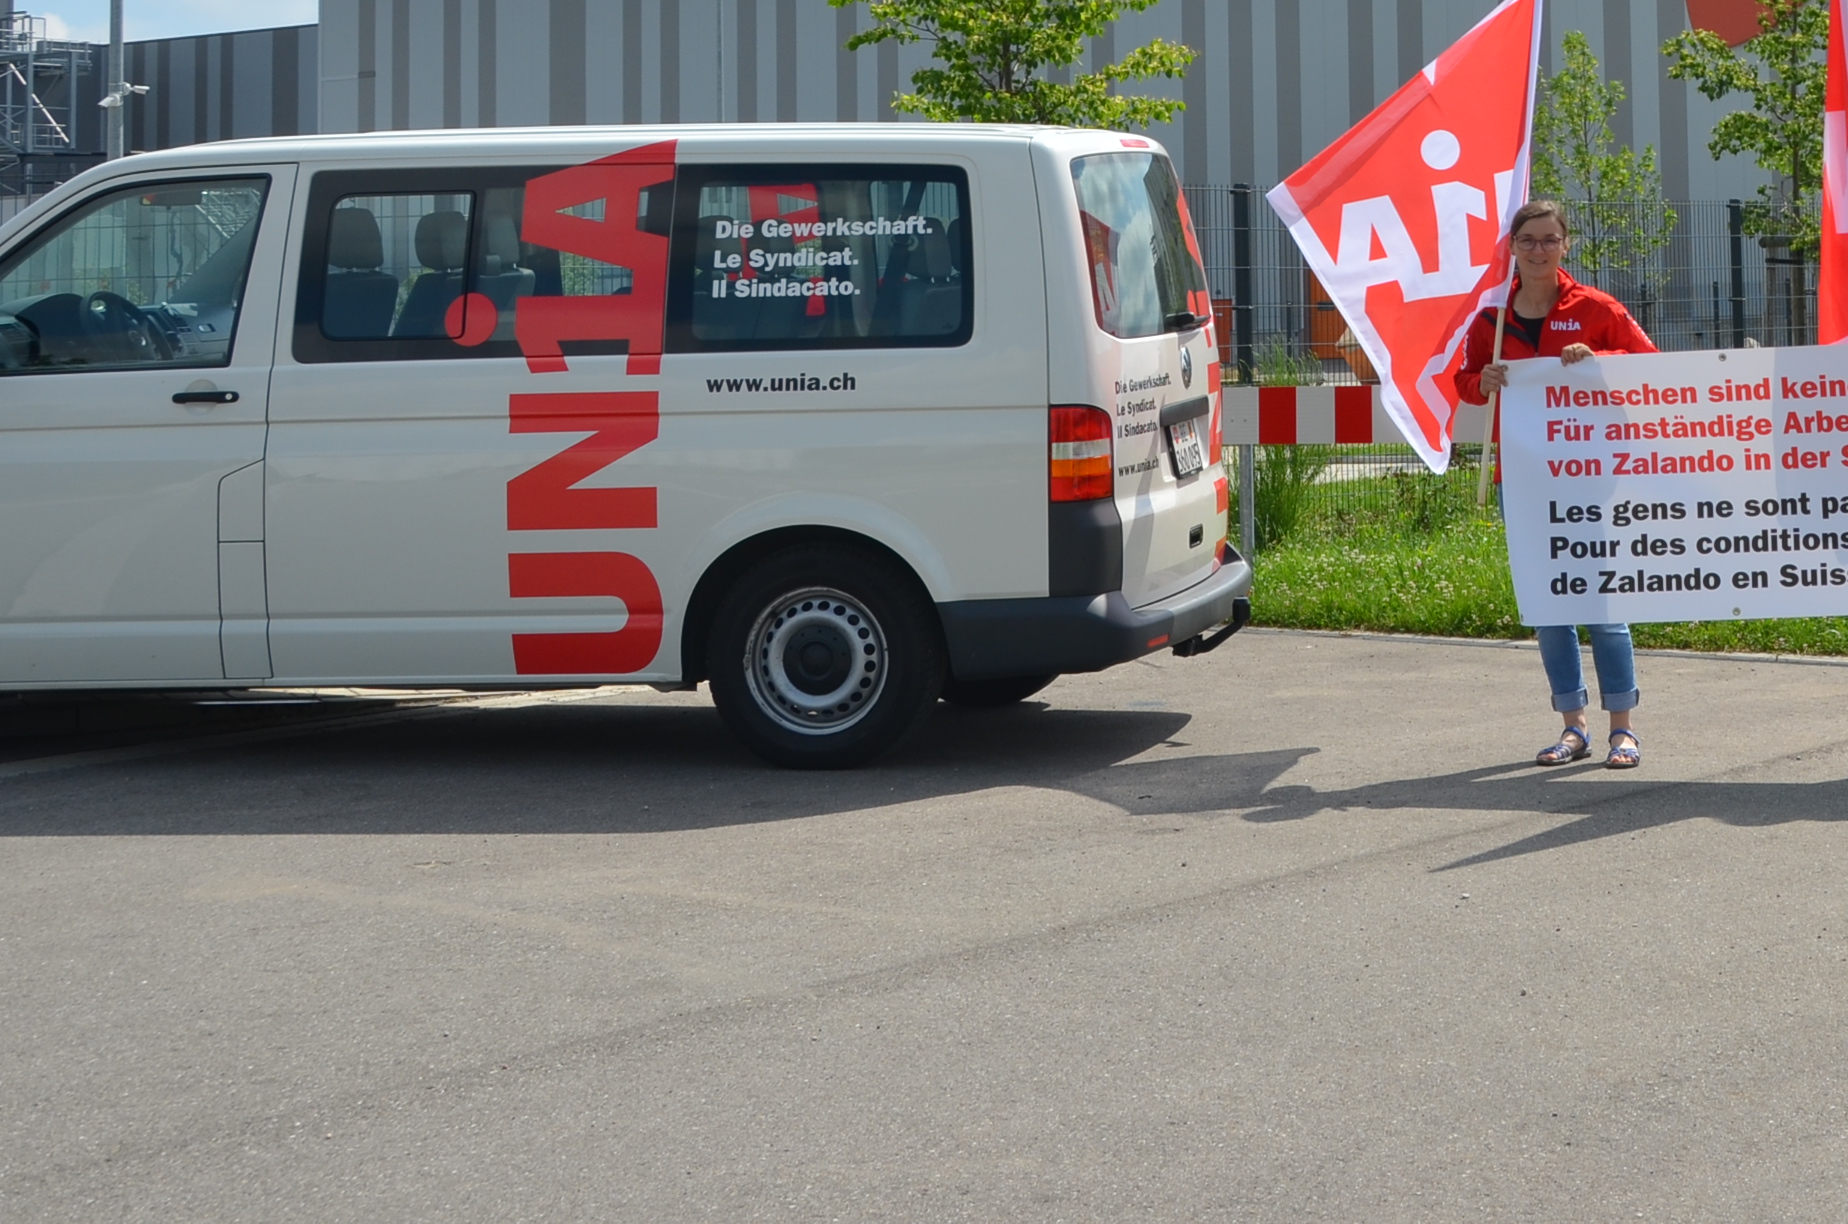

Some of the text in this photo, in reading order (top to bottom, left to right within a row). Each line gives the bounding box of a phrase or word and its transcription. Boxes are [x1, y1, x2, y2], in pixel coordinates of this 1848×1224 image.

[715, 216, 933, 239] Die Gewerkschaft.
[713, 247, 859, 271] Le Syndicat.
[712, 278, 861, 298] Il Sindacato.
[706, 373, 856, 393] www.unia.ch
[1115, 373, 1171, 394] Die Gewerkschaft.
[1546, 383, 1699, 408] Menschen
[1708, 377, 1772, 403] sind
[1116, 397, 1157, 417] Le Syndicat.
[1124, 419, 1158, 437] Sindacato.
[1547, 420, 1595, 442] Für
[1605, 413, 1773, 442] anständige
[1118, 455, 1159, 476] www.unia.ch
[1548, 458, 1602, 477] von
[1613, 449, 1735, 476] Zalando
[1744, 447, 1772, 471] in
[1781, 446, 1832, 470] der
[1549, 500, 1602, 524] Les
[1612, 500, 1686, 527] gens
[1697, 500, 1733, 519] ne
[1744, 493, 1811, 517] sont
[1550, 536, 1620, 559] Pour
[1630, 533, 1686, 557] des
[1550, 572, 1588, 596] de
[1598, 568, 1721, 594] Zalando
[1732, 571, 1768, 589] en
